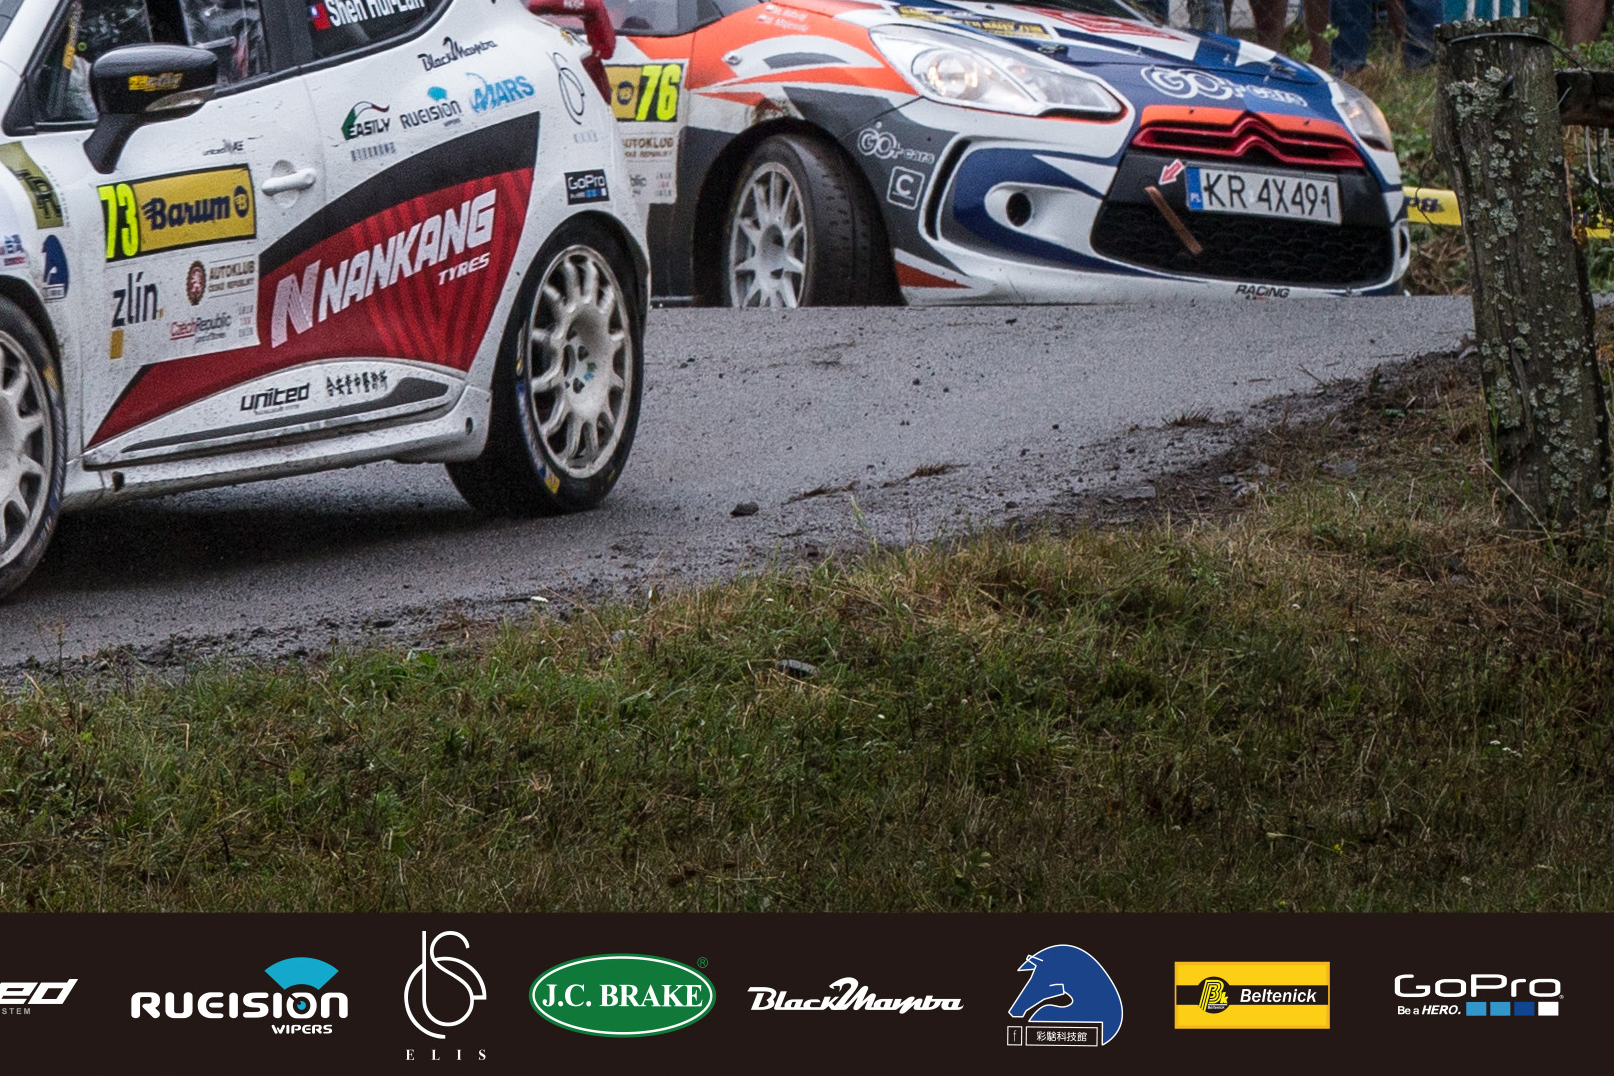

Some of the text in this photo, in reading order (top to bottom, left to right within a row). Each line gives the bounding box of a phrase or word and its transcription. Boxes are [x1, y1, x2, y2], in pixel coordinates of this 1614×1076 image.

[635, 63, 682, 121] 76
[347, 116, 392, 141] EASILY
[567, 173, 607, 190] GoPro
[1204, 171, 1247, 210] KR
[1256, 177, 1332, 219] 4X491
[97, 182, 140, 259] 73
[140, 194, 231, 232] Barum
[318, 188, 498, 323] NANKANG
[437, 251, 492, 287] TYRES
[1234, 284, 1291, 300] RACING
